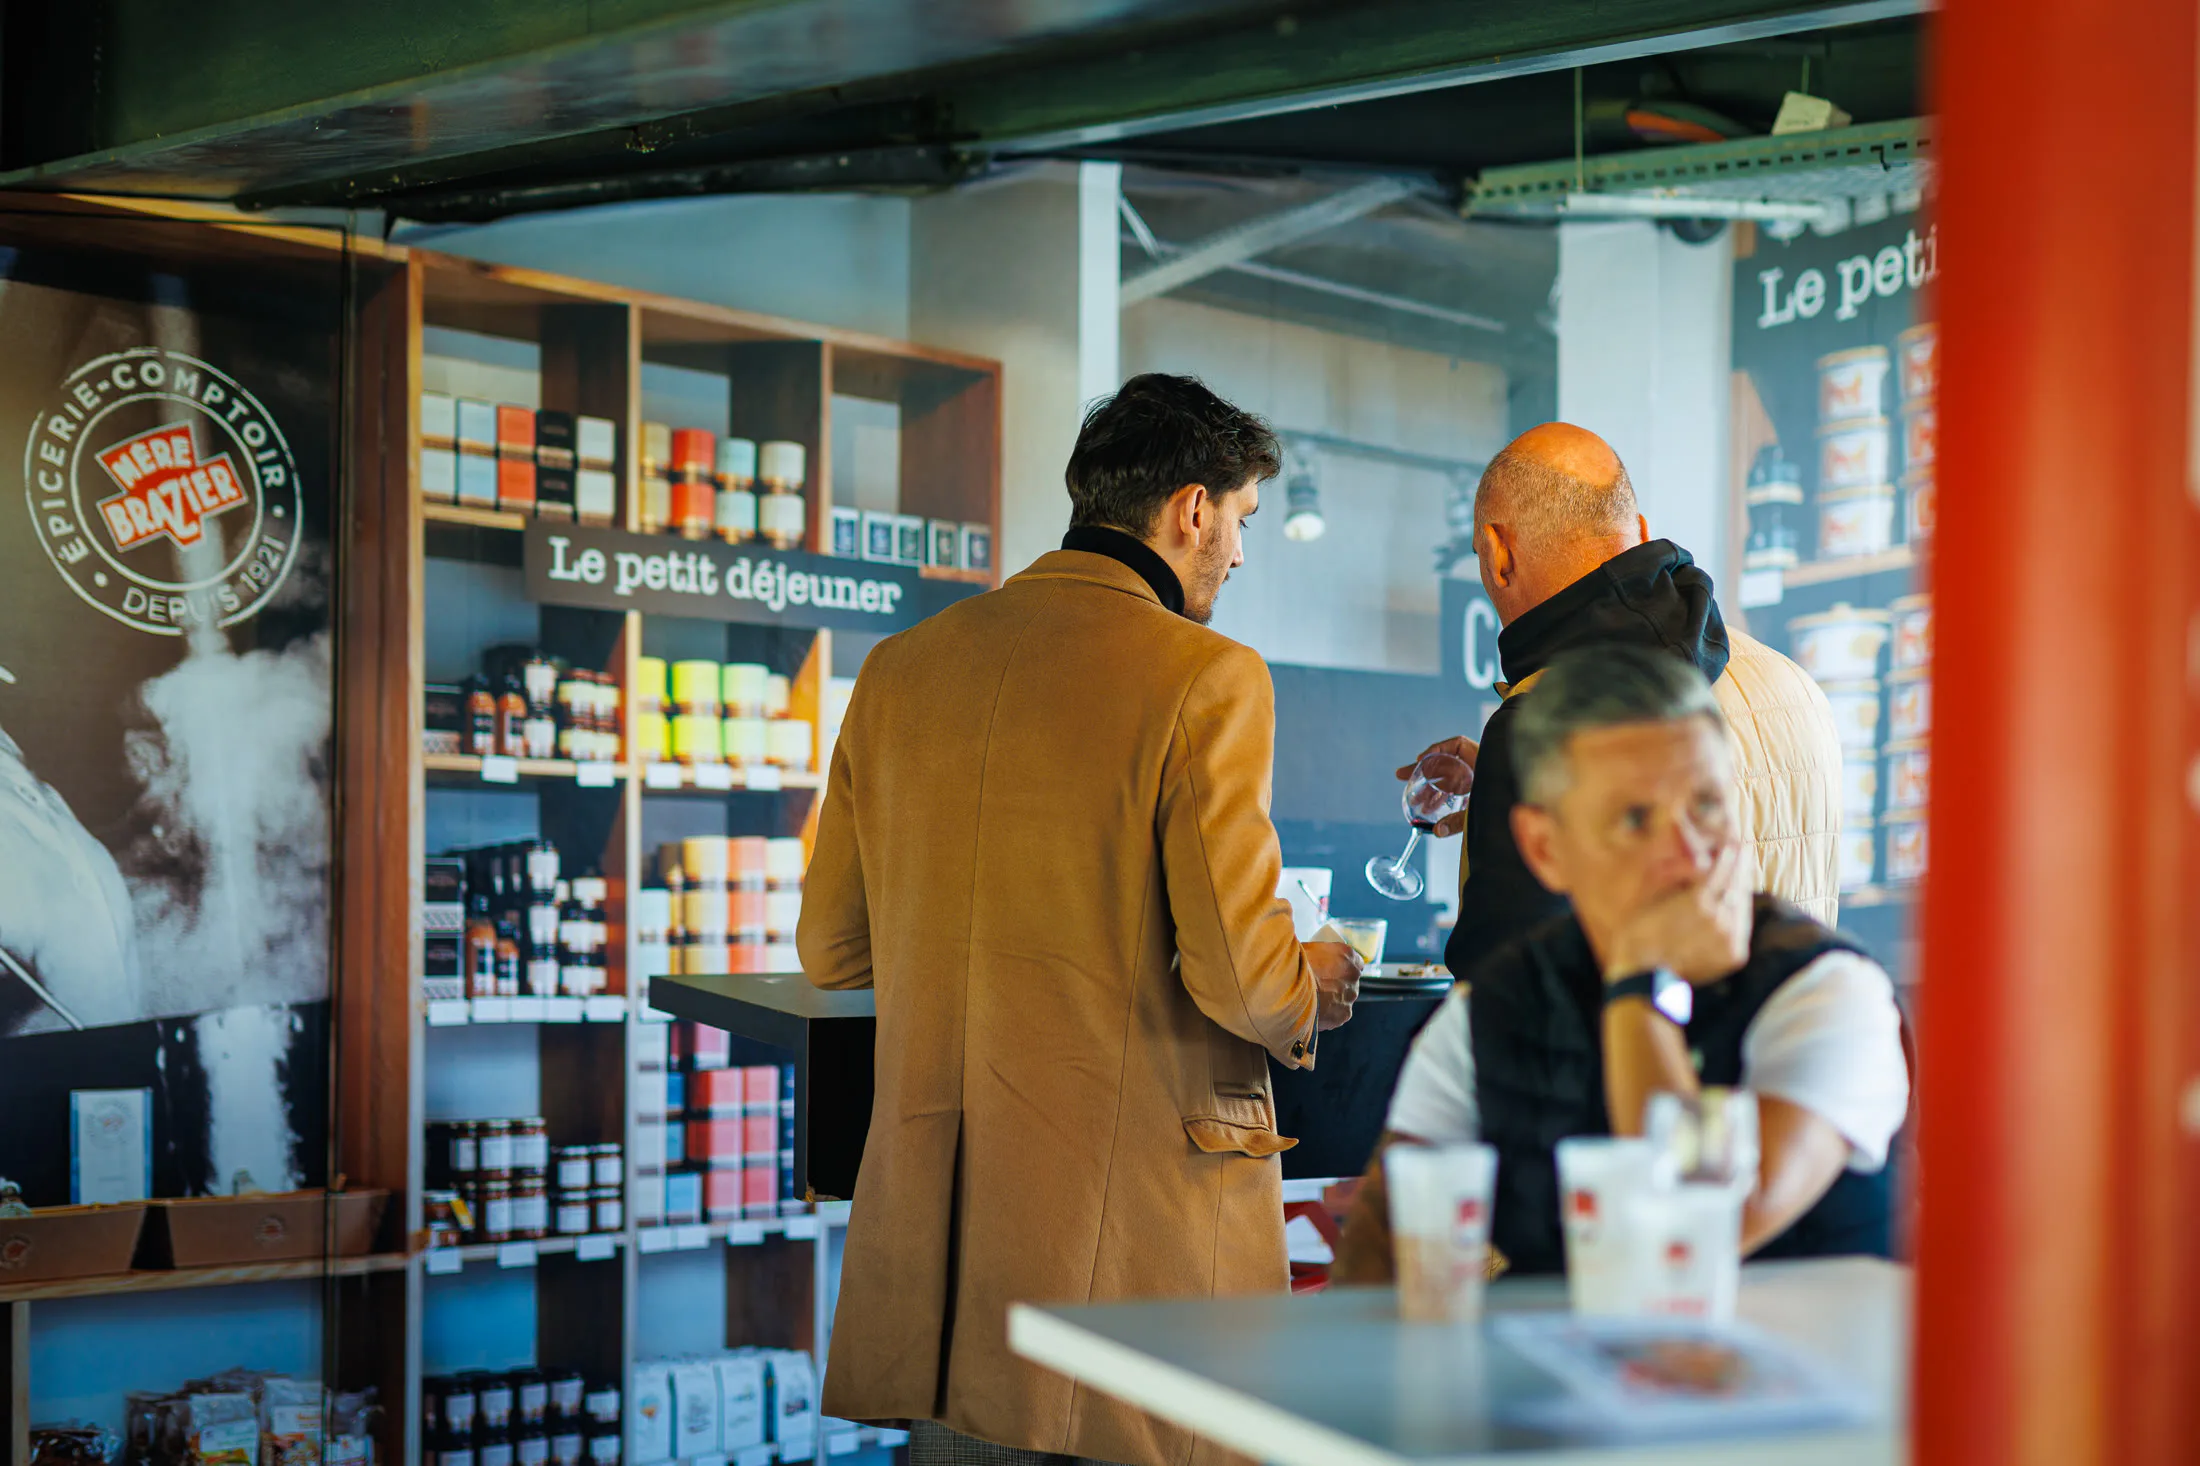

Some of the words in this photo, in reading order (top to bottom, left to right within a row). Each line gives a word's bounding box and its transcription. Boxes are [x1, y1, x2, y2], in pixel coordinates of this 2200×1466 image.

[1757, 267, 1826, 329] Le
[239, 534, 287, 593] 1921
[548, 537, 606, 583] Le
[614, 546, 720, 596] petit
[725, 556, 903, 613] déjeuner
